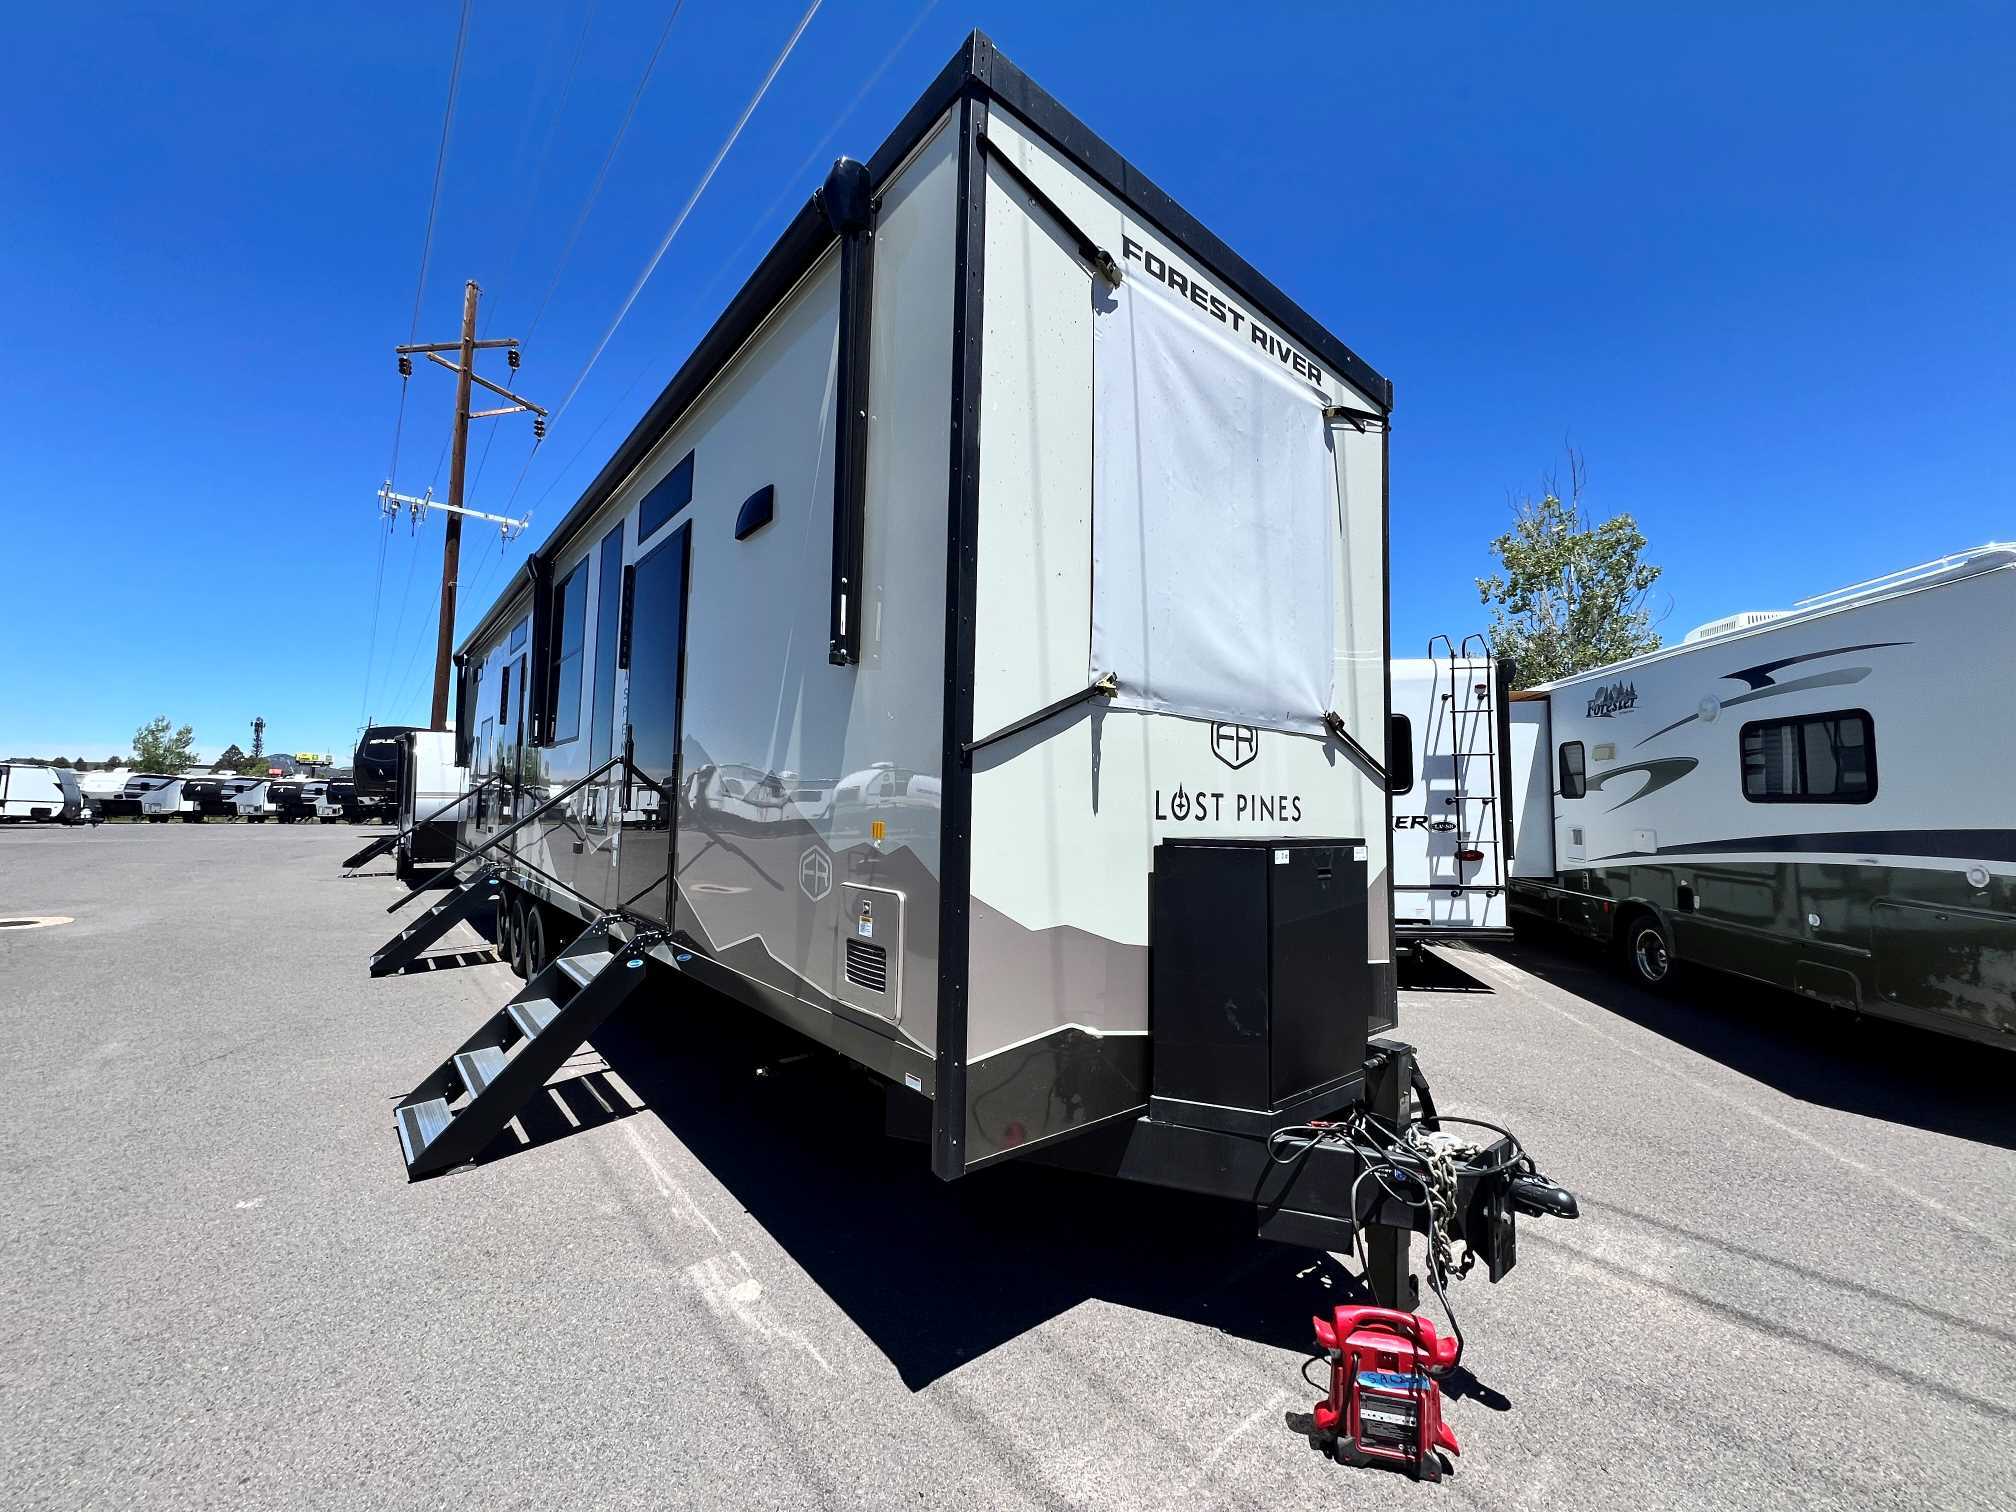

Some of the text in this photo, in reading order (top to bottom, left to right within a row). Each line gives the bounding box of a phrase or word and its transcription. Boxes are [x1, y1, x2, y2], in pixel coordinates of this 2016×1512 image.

[1122, 234, 1323, 387] FOREST RIVER
[1586, 697, 1638, 718] Forester
[1155, 782, 1302, 822] LOST PINES
[1392, 816, 1430, 832] ER
